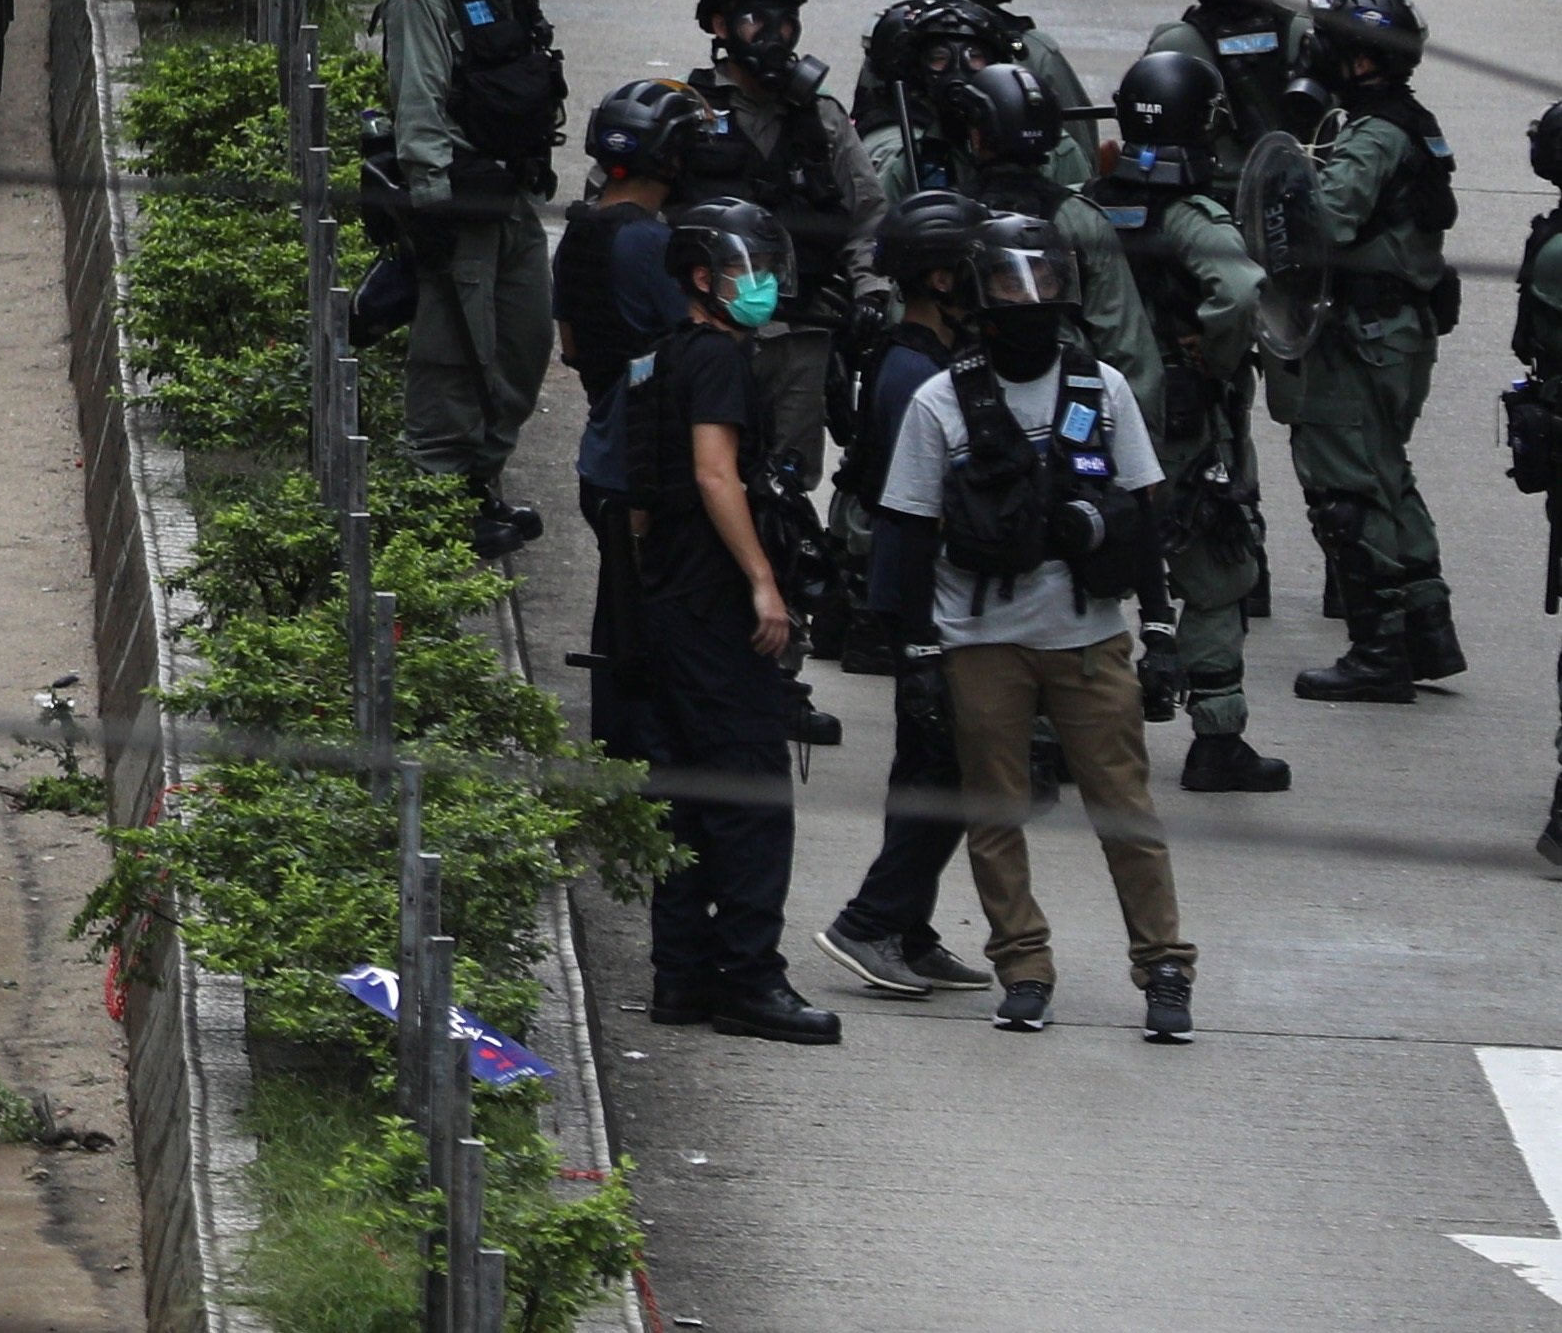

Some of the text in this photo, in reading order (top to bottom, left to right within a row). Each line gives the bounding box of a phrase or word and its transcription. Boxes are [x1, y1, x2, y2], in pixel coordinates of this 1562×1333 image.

[1134, 102, 1162, 115] MAR
[1144, 115, 1153, 125] 3
[1263, 202, 1292, 274] POLICE
